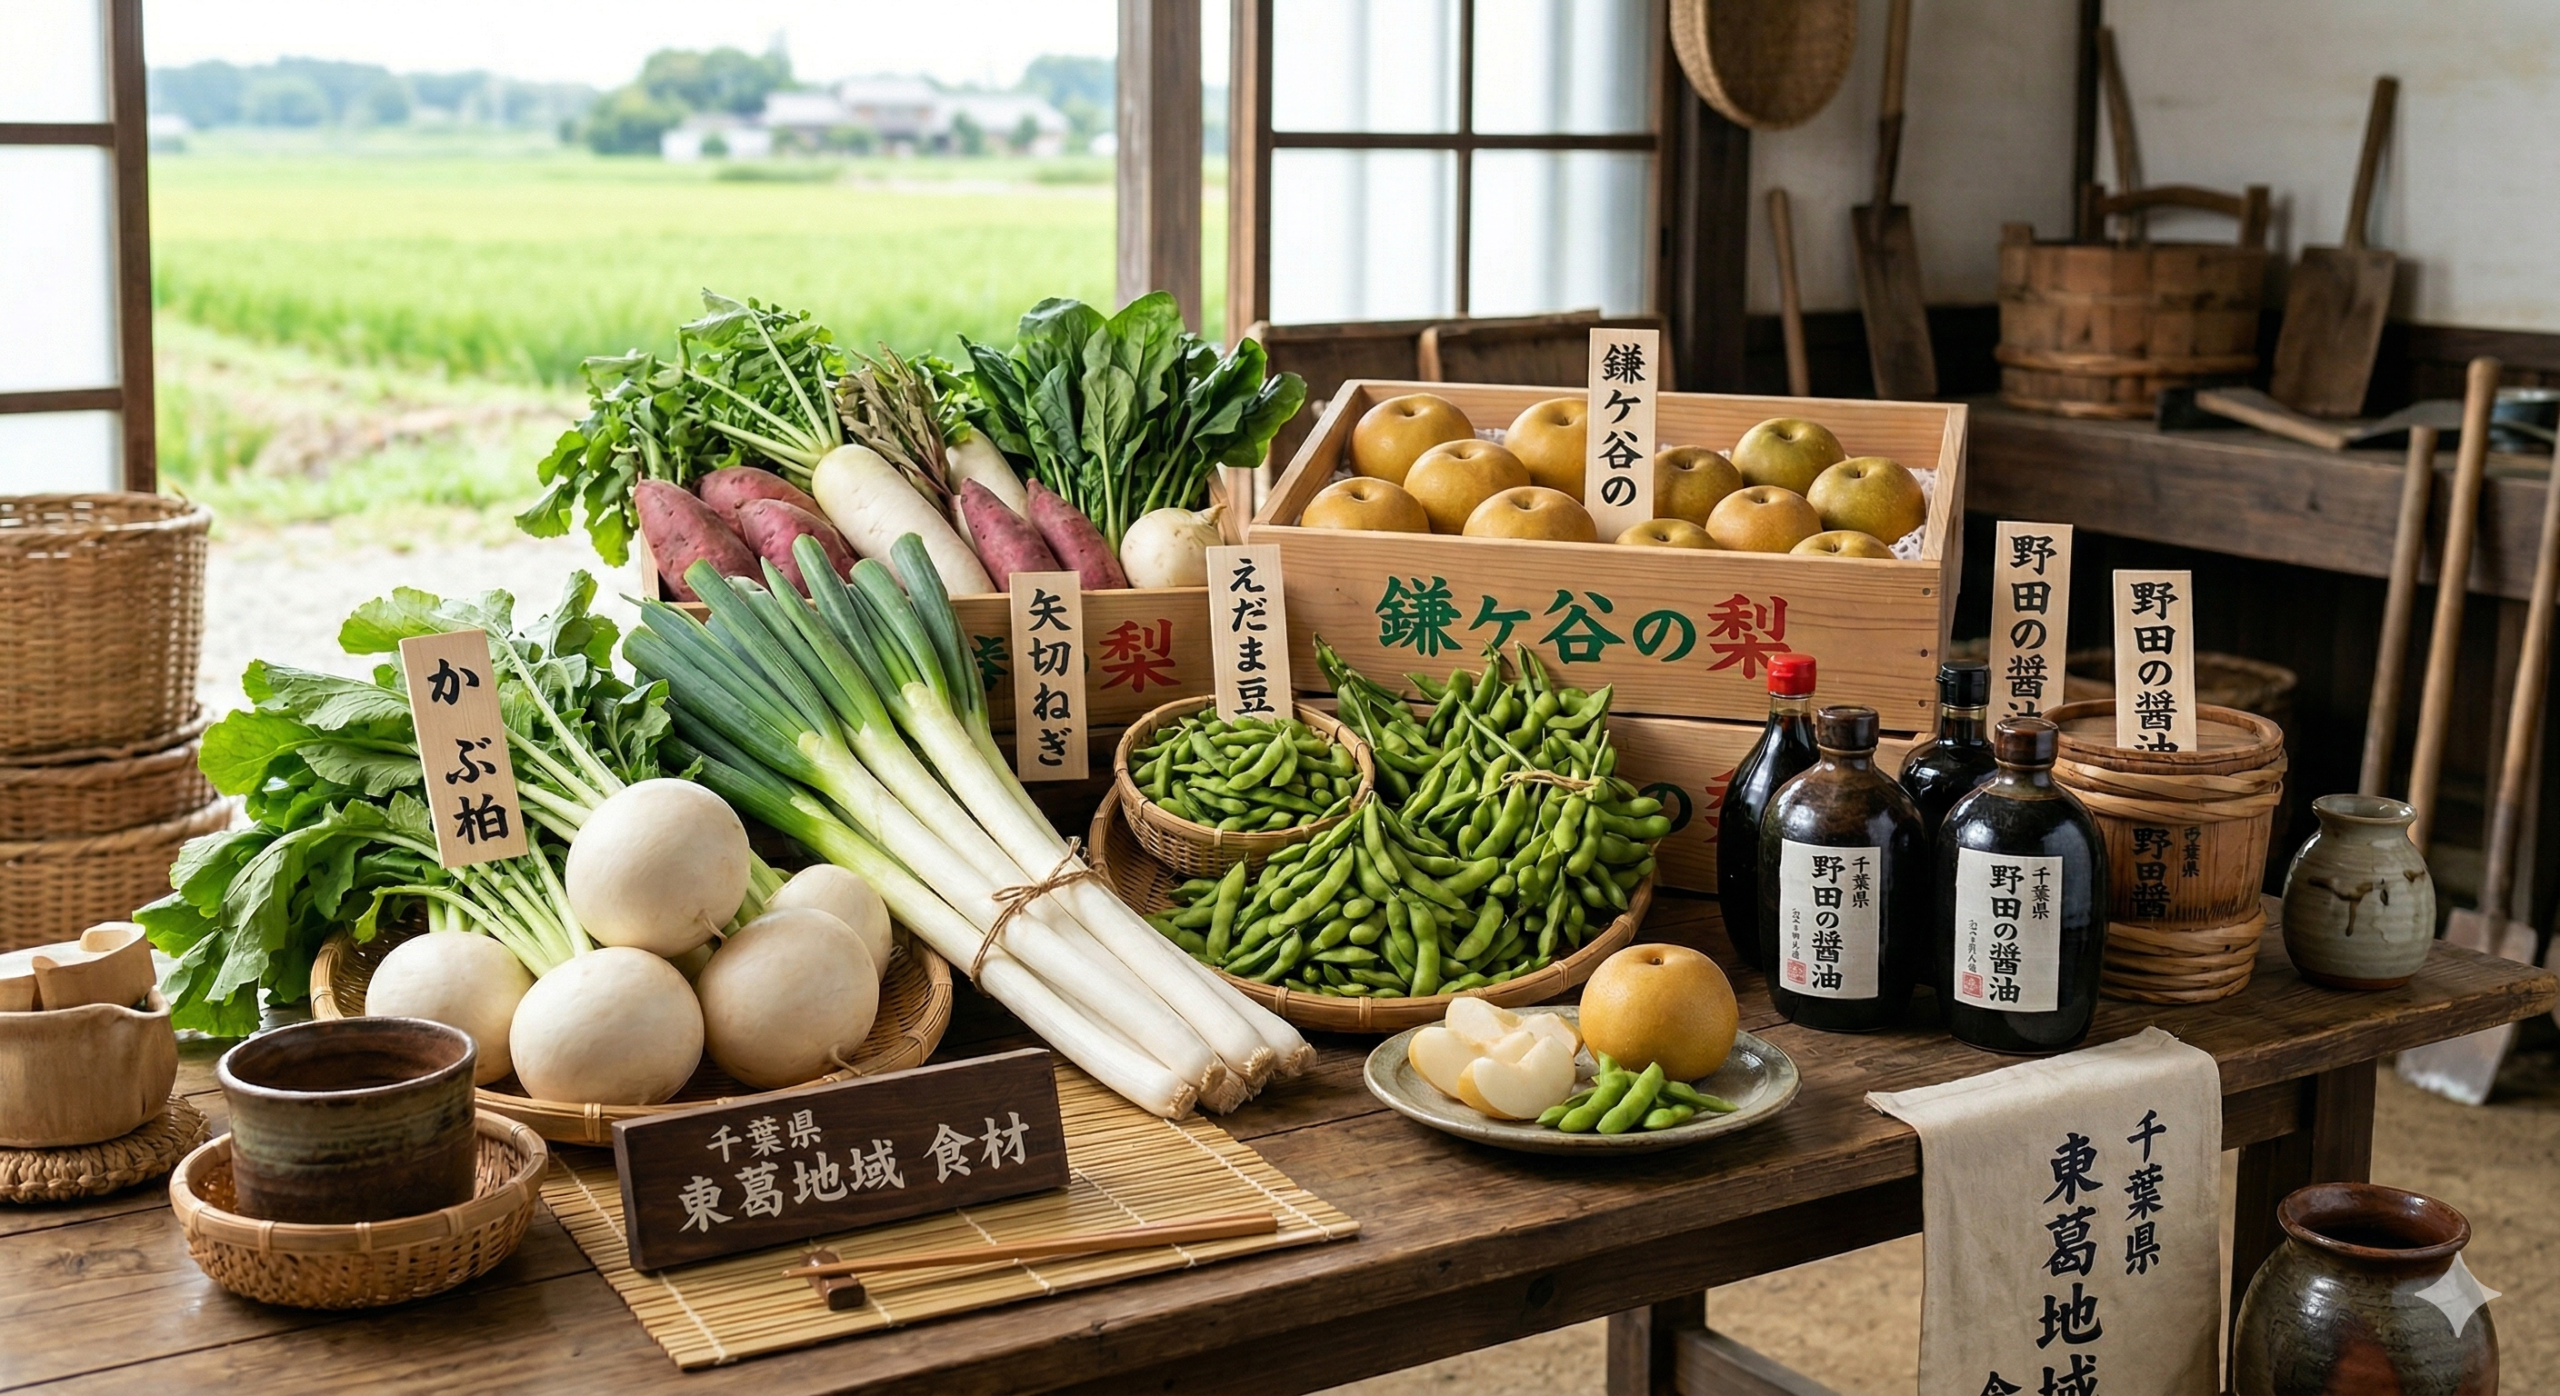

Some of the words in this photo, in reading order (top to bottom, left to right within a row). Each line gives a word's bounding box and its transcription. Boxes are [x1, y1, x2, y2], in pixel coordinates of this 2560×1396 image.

[1599, 342, 1647, 508] 鎌ケ谷の
[1027, 587, 1073, 767] 矢切ねぎ
[1229, 557, 1275, 716] えだま豆
[426, 657, 510, 846] かぶ柏
[1811, 855, 1846, 991] 野田の醤油
[1851, 855, 1871, 909] 千葉県
[1988, 864, 2025, 1004] 野田の醤油
[2030, 866, 2051, 920] 千葉県
[677, 1138, 906, 1234] 東葛地域
[921, 1111, 1031, 1184] 食材
[705, 1108, 823, 1164] 千葉県
[2123, 1109, 2167, 1276] 千葉県
